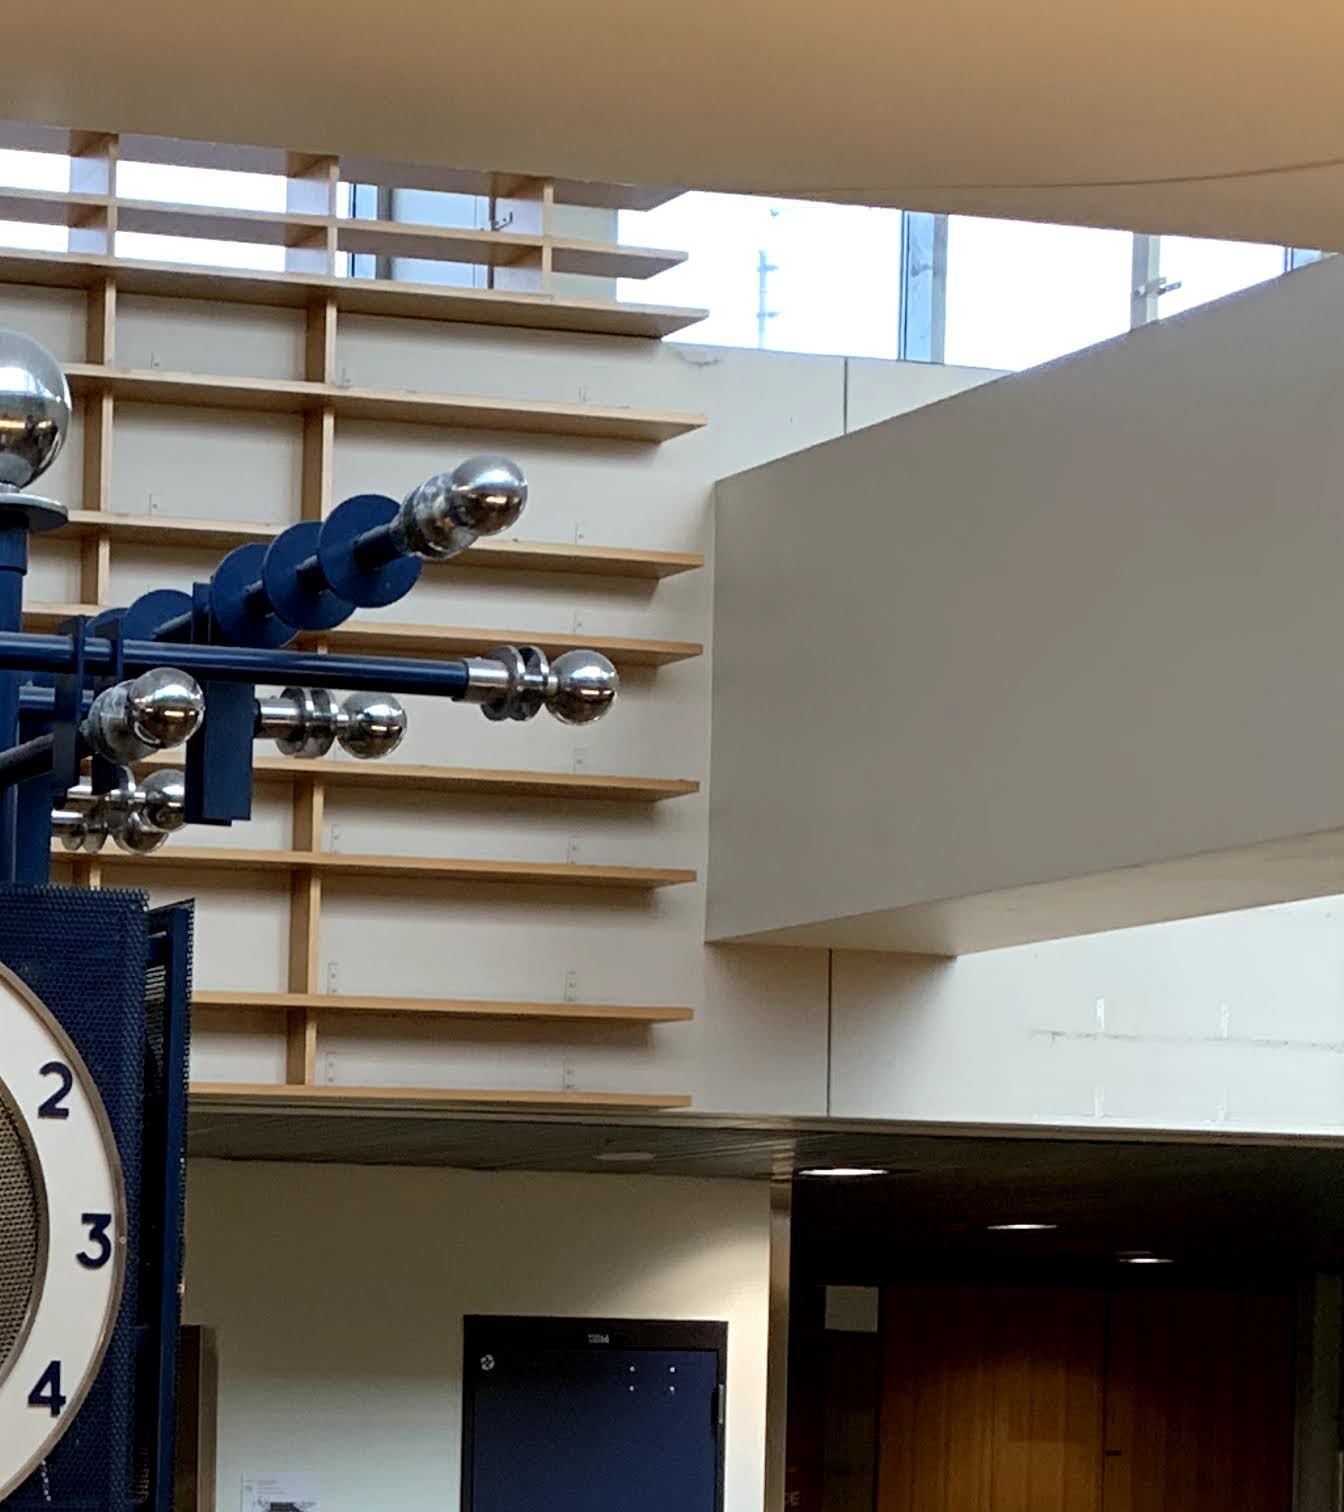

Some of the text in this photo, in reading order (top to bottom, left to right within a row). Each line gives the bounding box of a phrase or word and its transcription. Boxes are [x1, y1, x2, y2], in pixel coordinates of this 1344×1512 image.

[37, 1062, 74, 1119] 2
[76, 1213, 112, 1270] 3
[27, 1361, 67, 1417] 4
